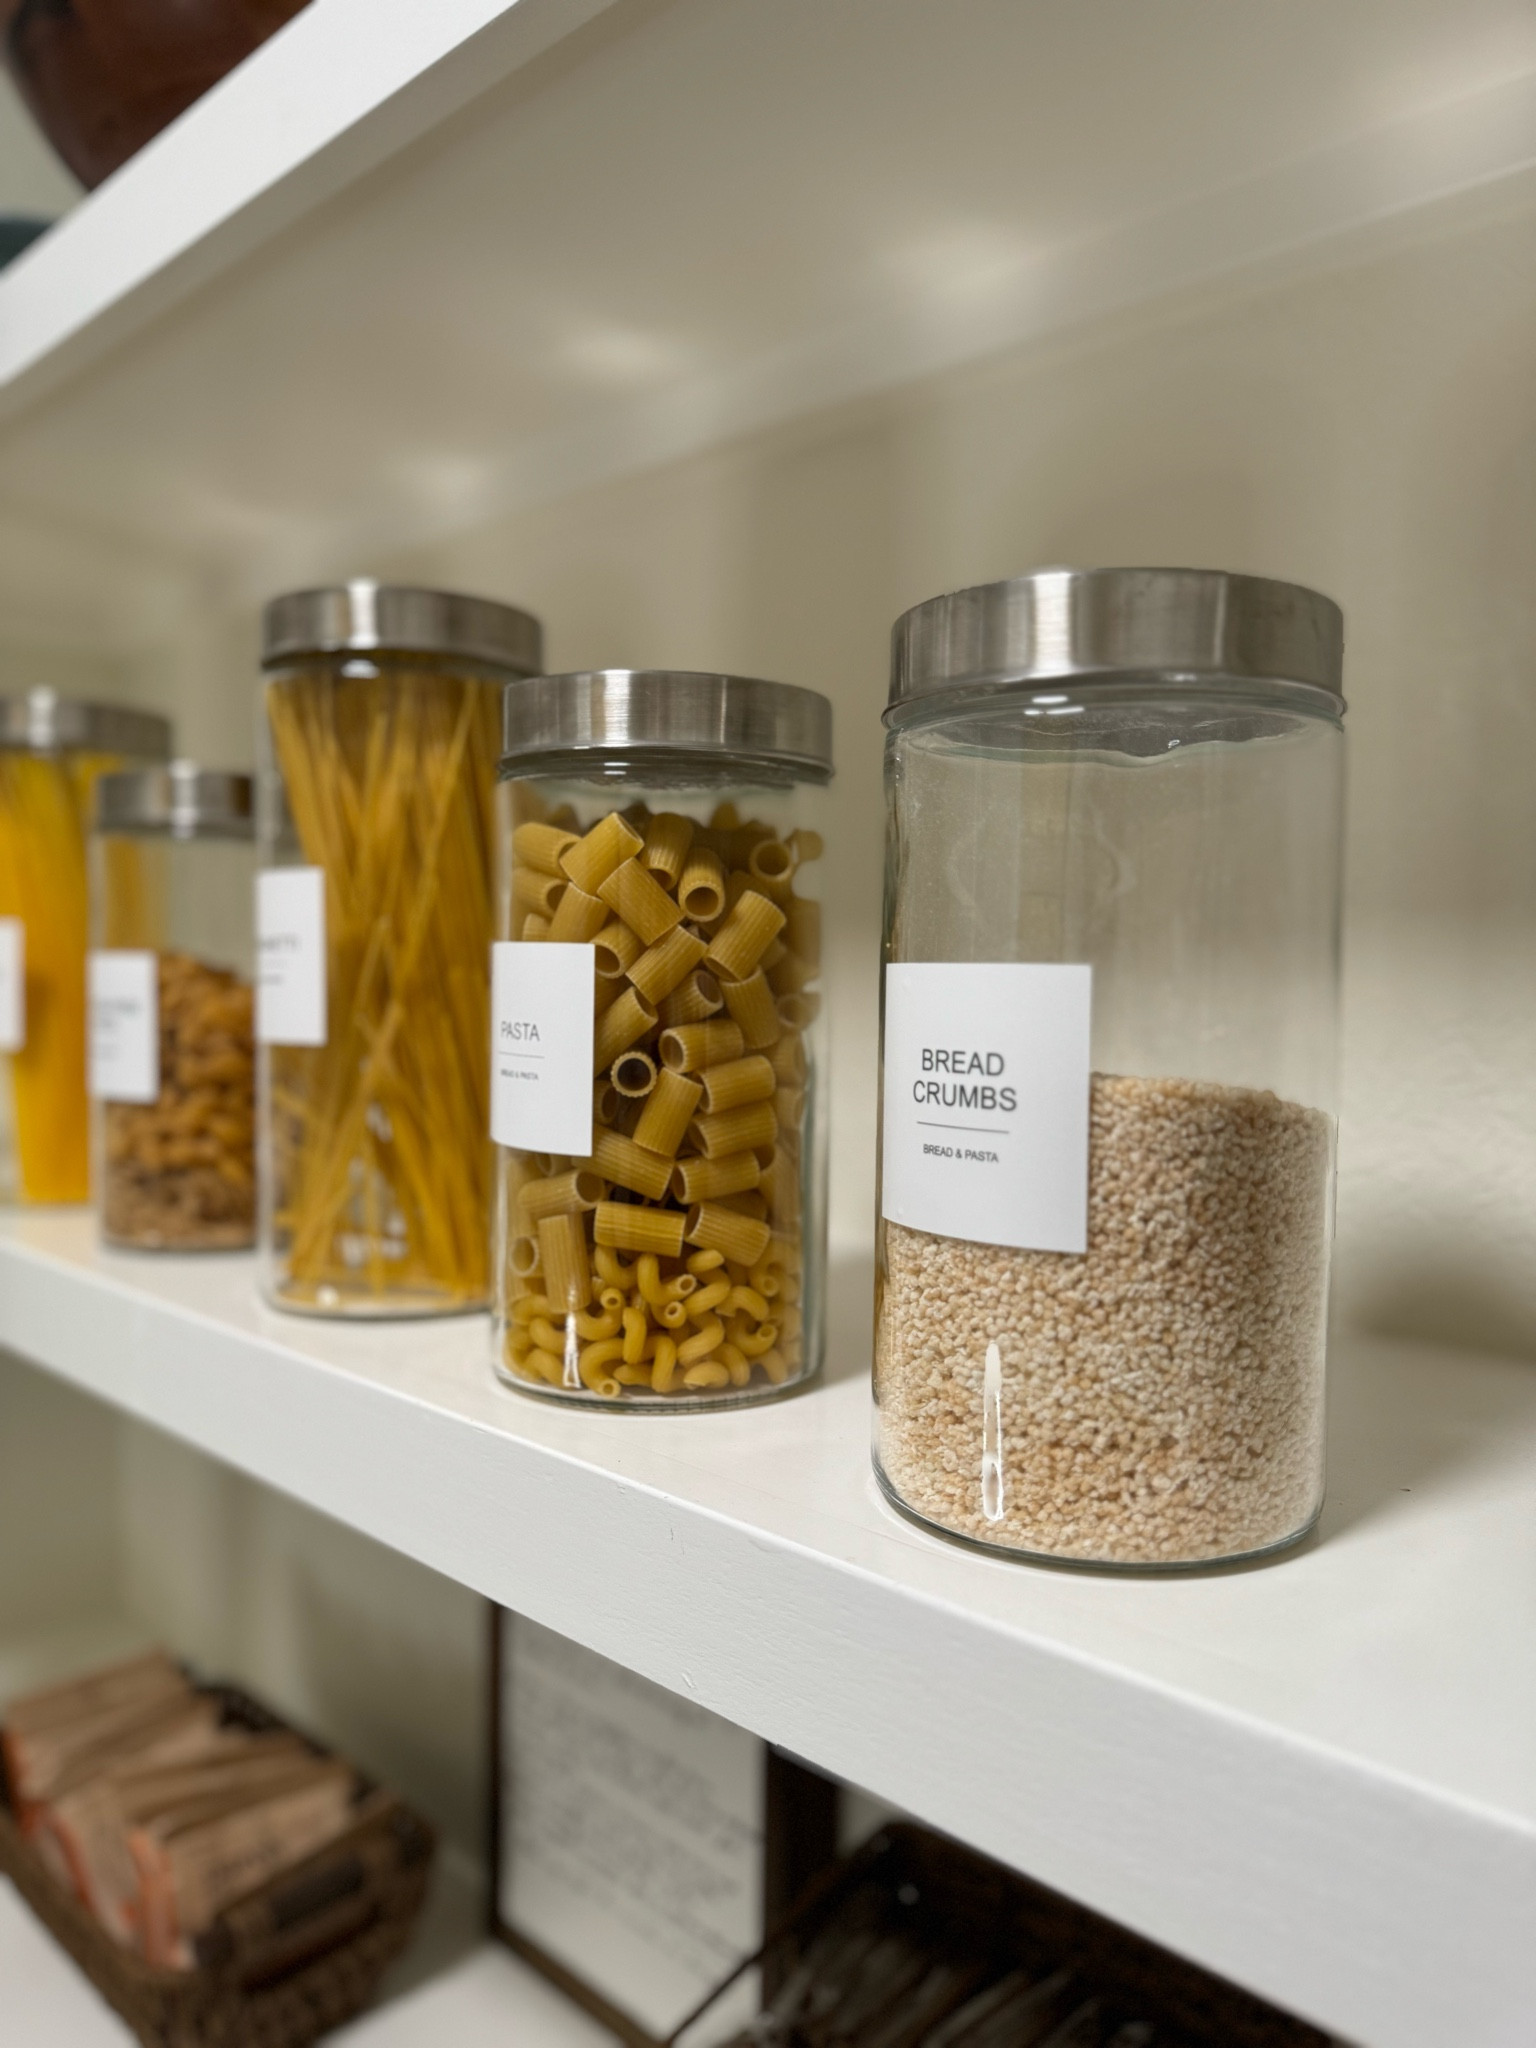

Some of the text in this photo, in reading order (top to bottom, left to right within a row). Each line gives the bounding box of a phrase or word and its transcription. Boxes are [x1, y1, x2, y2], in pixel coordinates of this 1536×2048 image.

[501, 1021, 540, 1041] PASTA
[921, 1048, 1005, 1076] BREAD
[913, 1080, 1017, 1112] CRUMBS
[923, 1143, 999, 1164] BREAD & PASTA
